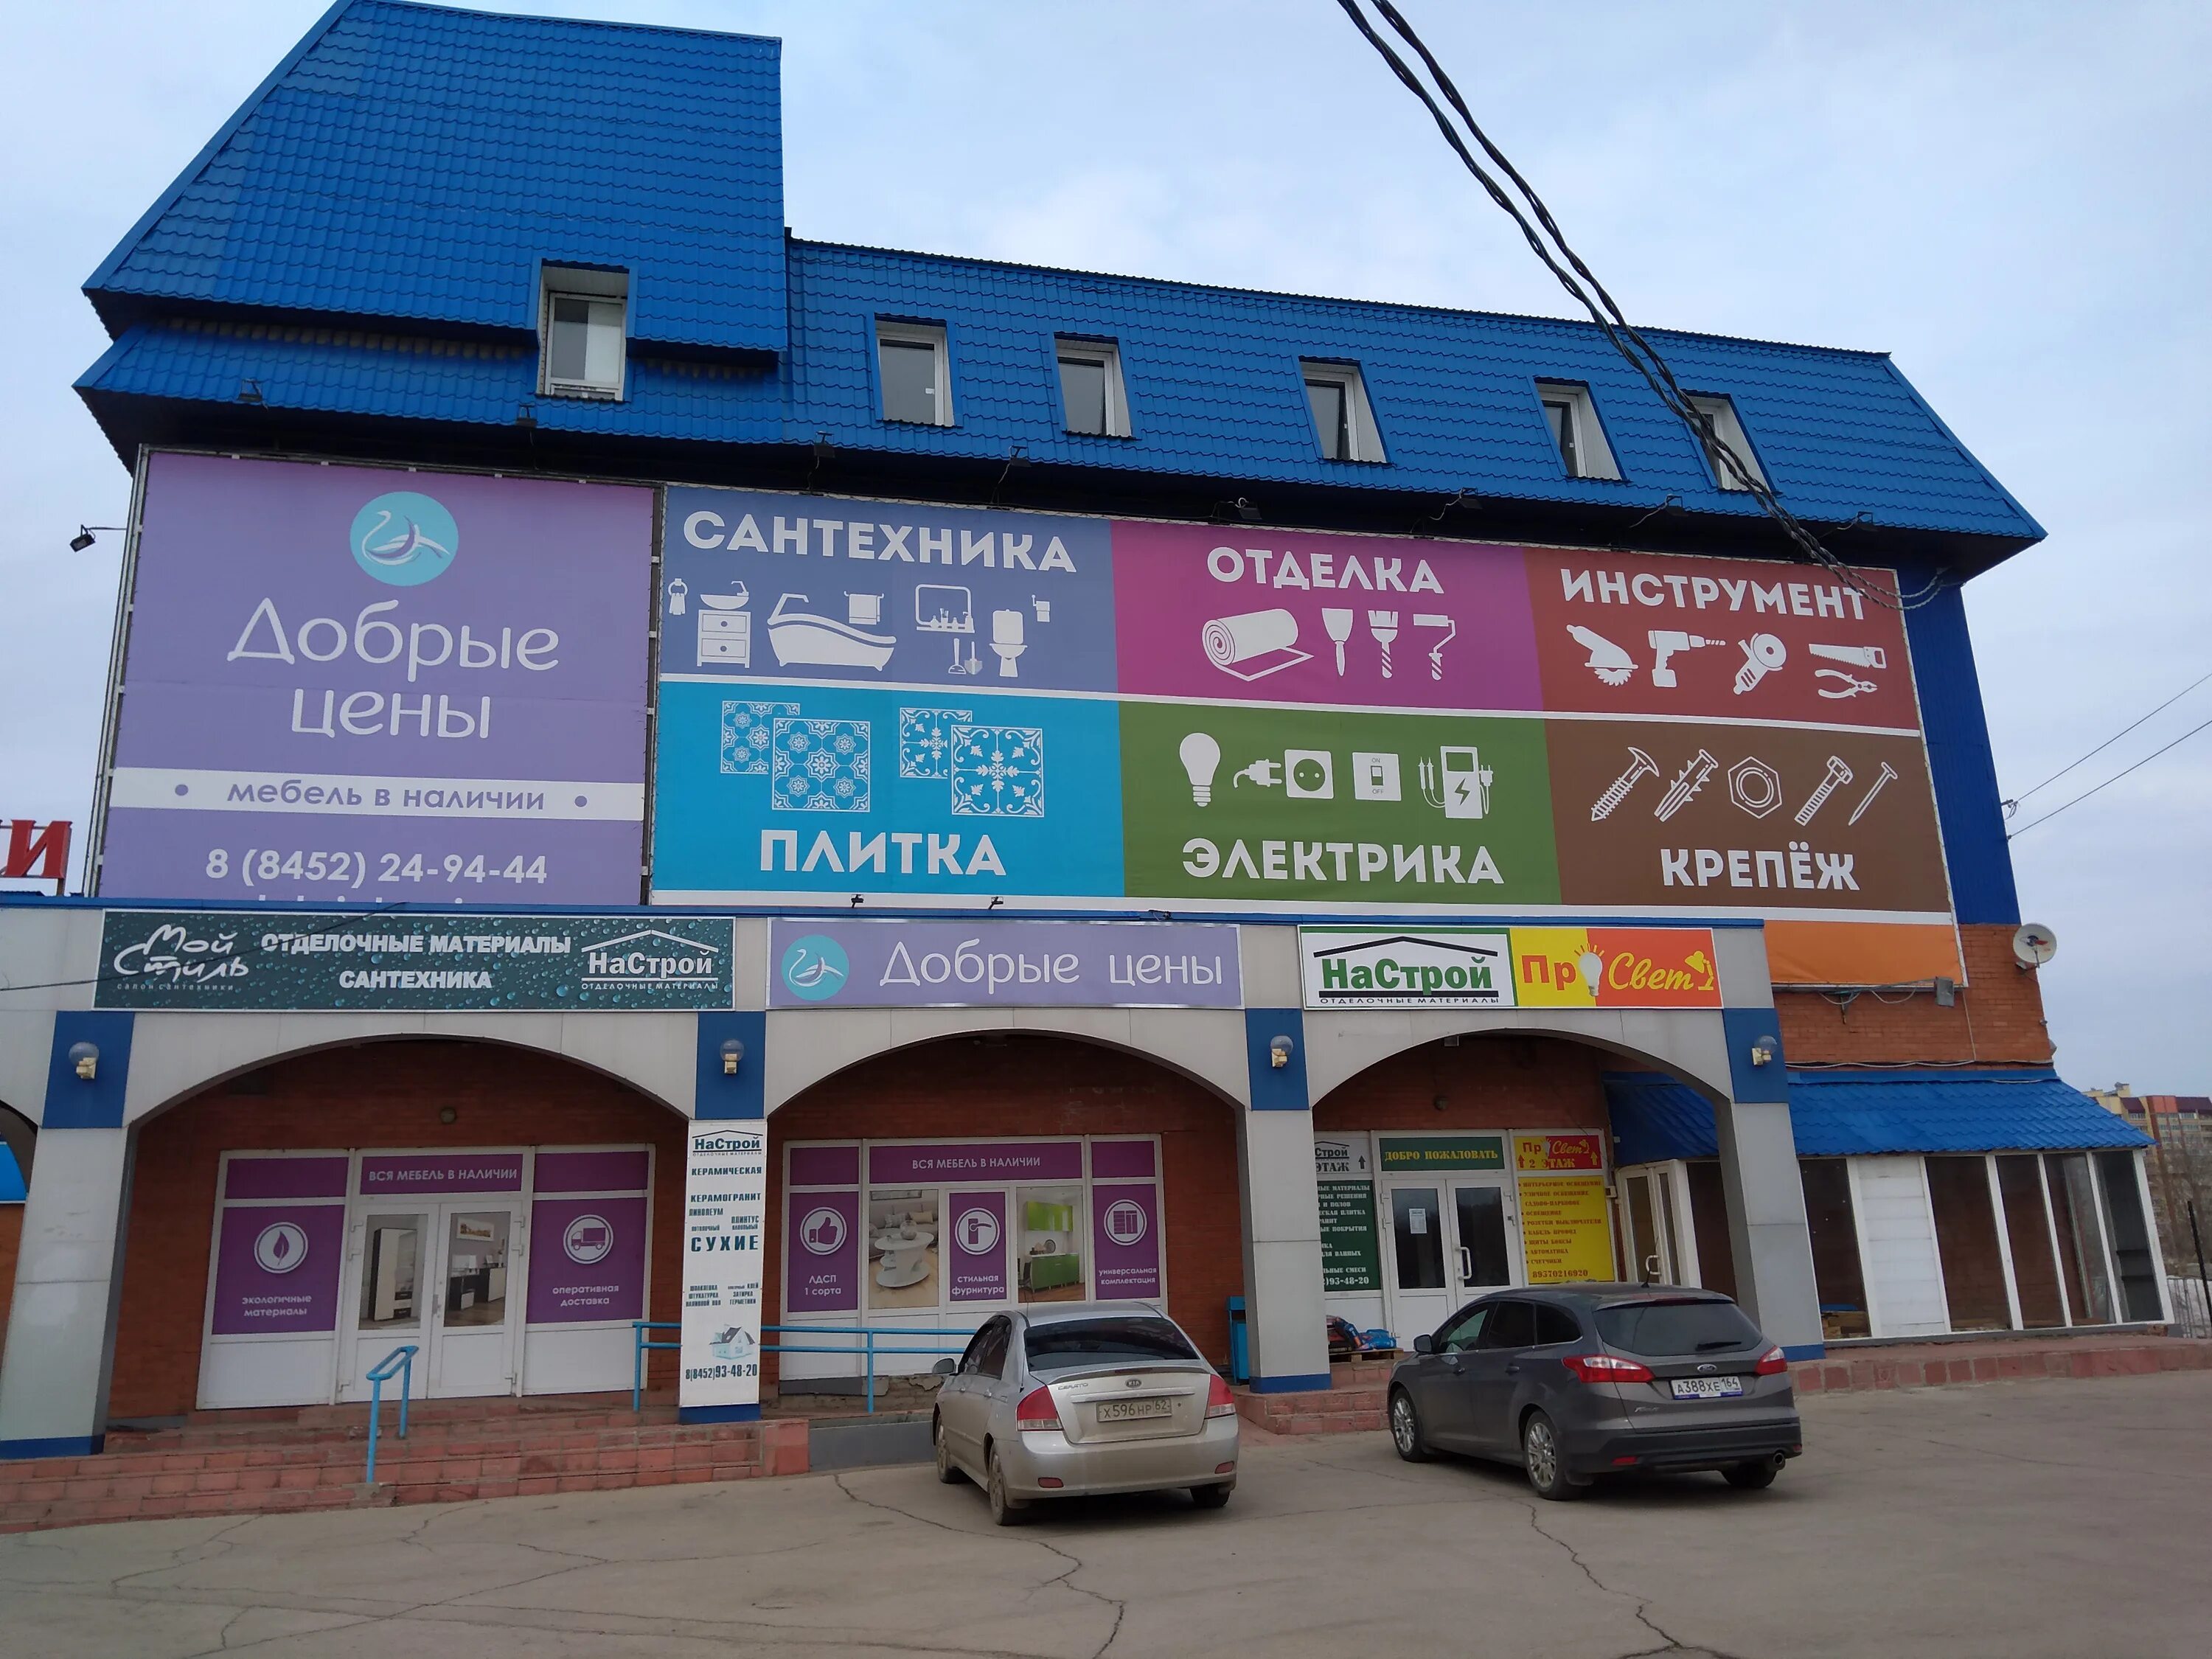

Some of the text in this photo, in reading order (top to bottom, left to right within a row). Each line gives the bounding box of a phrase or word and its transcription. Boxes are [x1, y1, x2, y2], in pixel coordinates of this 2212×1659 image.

[684, 511, 1076, 573] САНТЕХНИКА
[1207, 546, 1444, 594] ОТДЕЛКА
[1560, 568, 1865, 620] ИНСТРУМЕНТ
[227, 598, 559, 682] Добрые
[292, 689, 490, 738] цены
[227, 779, 544, 810] мебель в наличии
[760, 830, 1006, 876] ПЛИТКА
[1182, 838, 1504, 884] ЭЛЕКТРИКА
[206, 849, 547, 888] 8 (8452) 24-94-44
[1660, 841, 1860, 891] КРЕПЁЖ
[144, 924, 238, 955] Мой
[261, 933, 571, 954] ОТДЕЛОЧНЫЕ МАТЕРИАЛЫ
[114, 942, 249, 983] Стиль
[589, 950, 712, 978] НаСтрой
[880, 939, 1222, 995] Добрые цены
[339, 970, 493, 990] САНТЕХНИКА
[1322, 956, 1492, 995] НаСтрой
[655, 982, 718, 990] МАТЕРИАЛЫ
[695, 1136, 760, 1150] НаСтрой
[1315, 1147, 1348, 1158] Строй
[1385, 1150, 1498, 1161] ДОБРО ПОЖАЛОВАТЬ
[692, 1166, 762, 1176] КЕРАМИЧЕСКАЯ
[912, 1157, 1040, 1169] ВСЯ МЕБЕЛЬ В НАЛИЧИИ
[1541, 1158, 1576, 1168] ЭТАЖ
[369, 1169, 517, 1180] ВСЯ МЕБЕЛЬ В НАЛИЧИИ
[690, 1193, 761, 1203] КЕРАМОГРАНИТ
[731, 1215, 759, 1223] ПЛИНТУС
[691, 1235, 758, 1251] СУХИЕ
[808, 1274, 837, 1284] ЛДСП
[957, 1274, 998, 1283] стильная
[1099, 1268, 1157, 1276] универсальная
[552, 1285, 619, 1295] оперативная
[812, 1287, 841, 1296] сорта
[951, 1285, 1004, 1296] фурнитура
[560, 1298, 610, 1307] доставка
